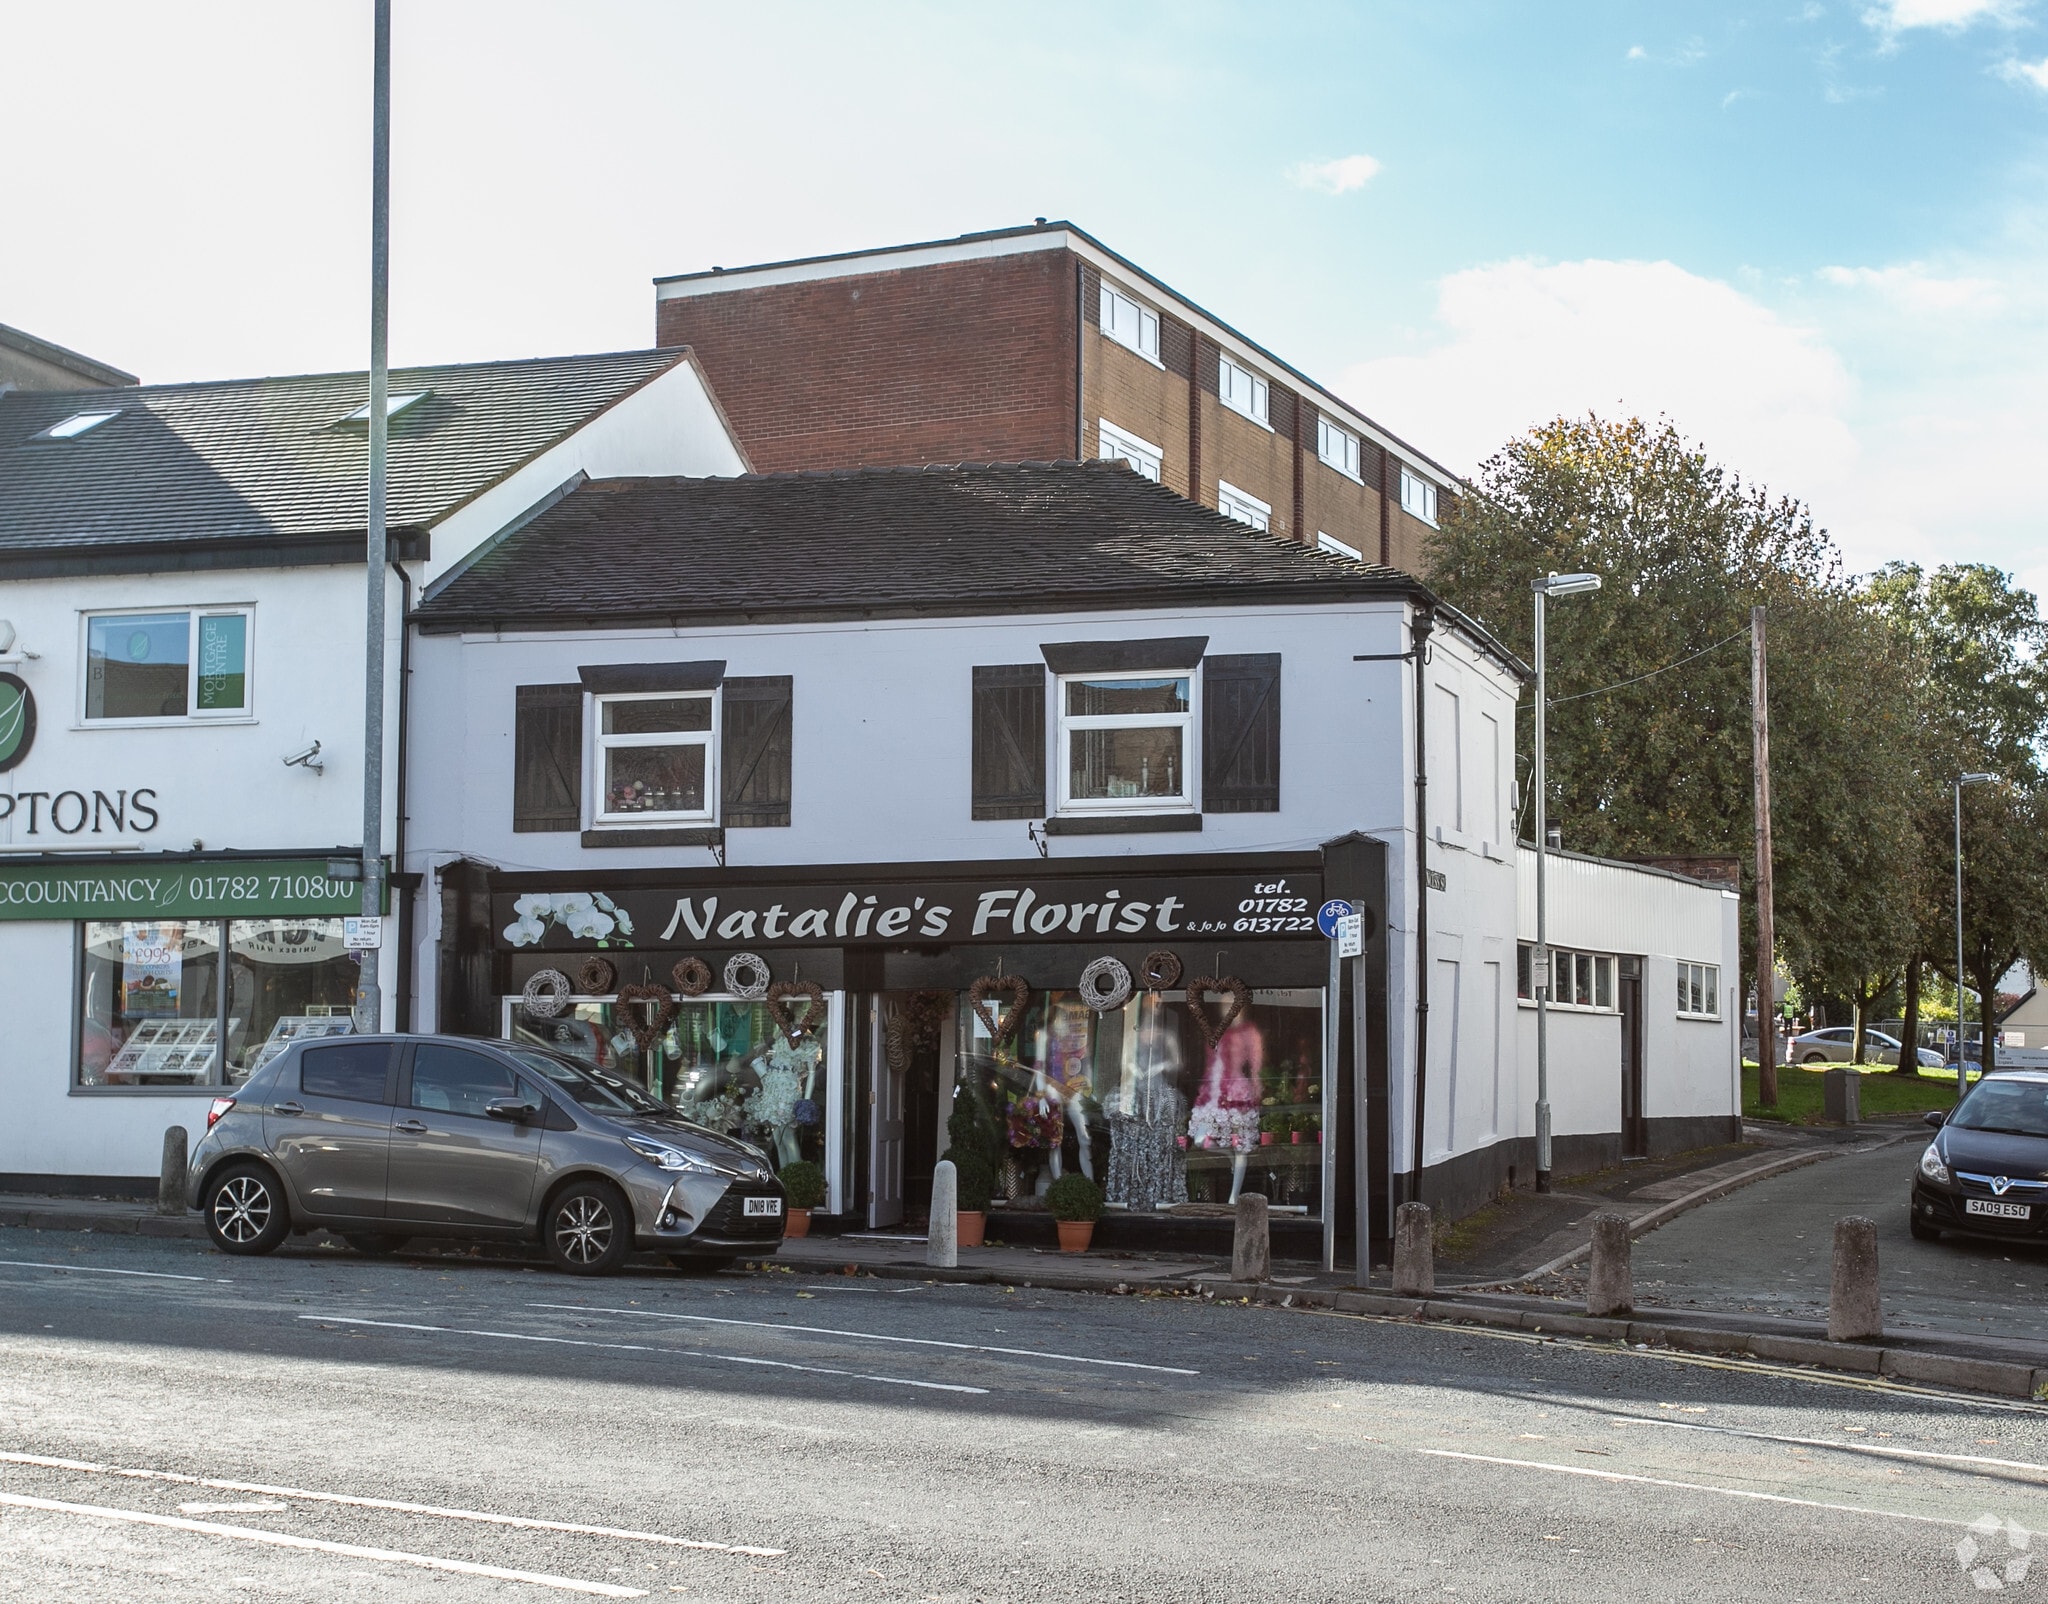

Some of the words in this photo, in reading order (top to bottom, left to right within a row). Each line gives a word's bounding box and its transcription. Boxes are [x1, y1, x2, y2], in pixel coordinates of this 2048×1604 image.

[203, 622, 217, 704] MORTGAGE
[215, 633, 228, 691] CENTRE
[189, 876, 259, 900] 01782
[267, 875, 354, 899] 710800
[1254, 879, 1291, 894] tel.
[659, 891, 952, 941] Natalie's
[971, 887, 1185, 936] Florist
[1186, 921, 1196, 931] &
[1238, 898, 1308, 913] 01782
[1233, 917, 1315, 933] 613722
[135, 947, 171, 964] £995
[1972, 1201, 2001, 1214] SA09
[2003, 1204, 2026, 1217] ESO
